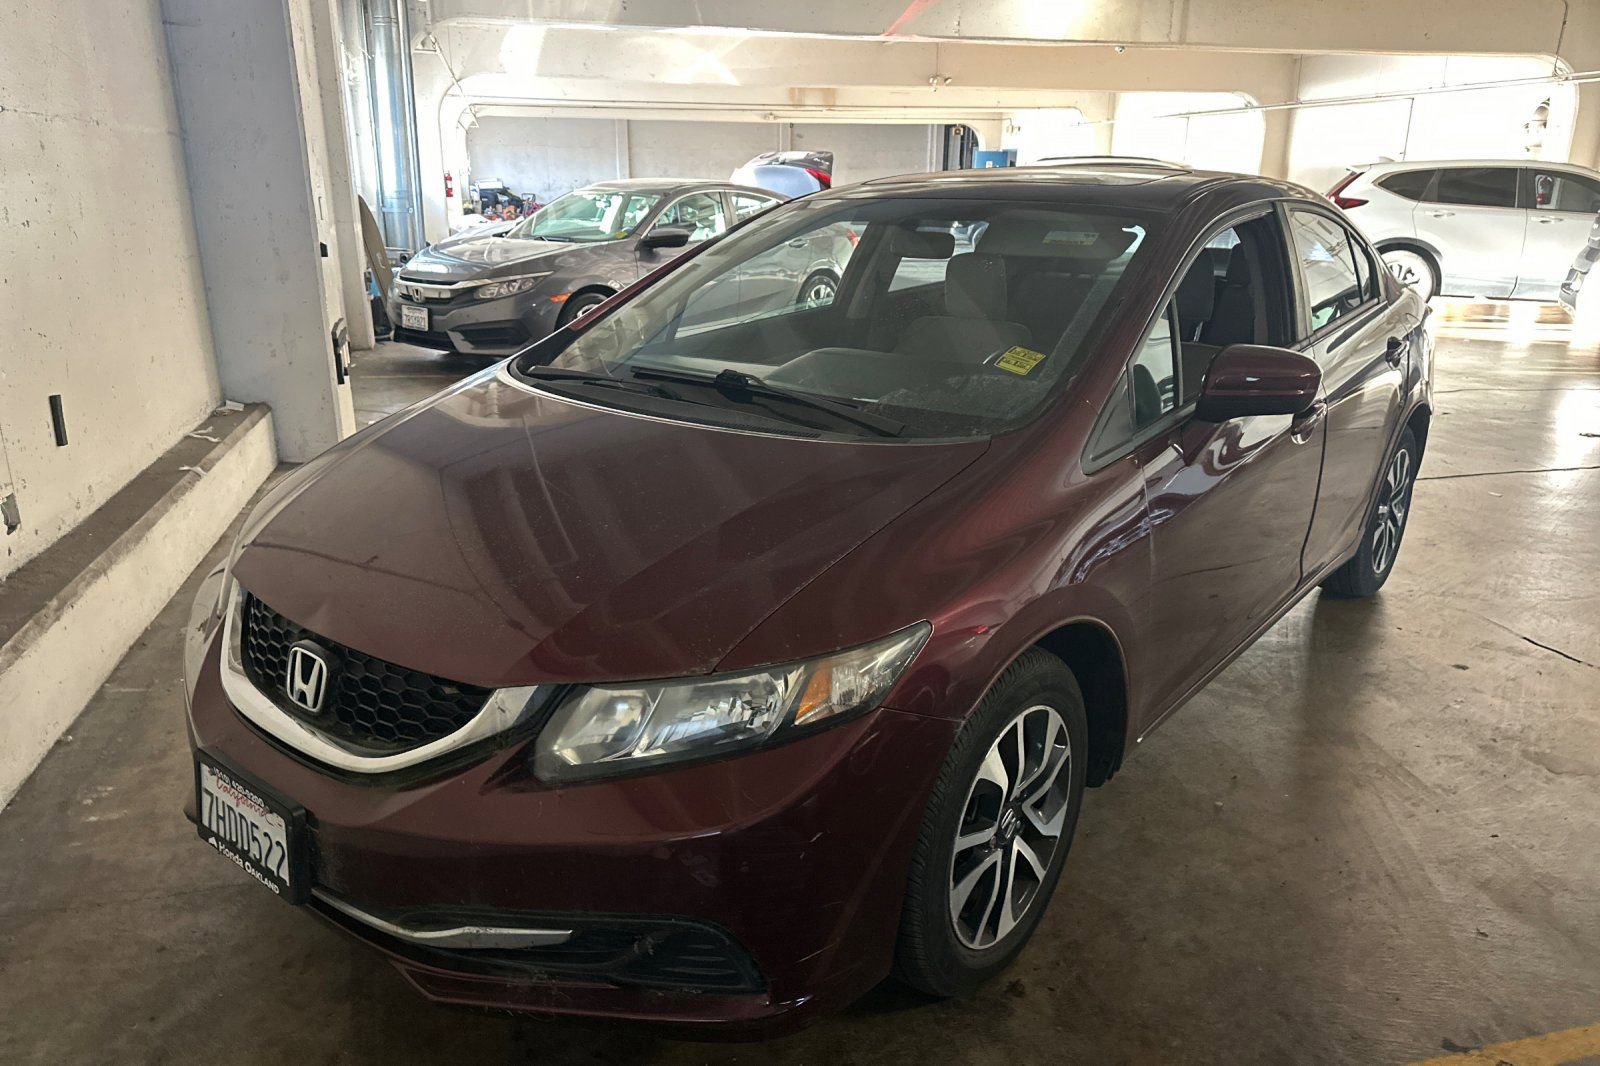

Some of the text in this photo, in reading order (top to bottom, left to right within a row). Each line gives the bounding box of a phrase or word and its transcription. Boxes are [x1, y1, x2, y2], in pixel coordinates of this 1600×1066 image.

[203, 787, 286, 877] 7HDD522
[218, 841, 280, 894] Honda OAKLAND
